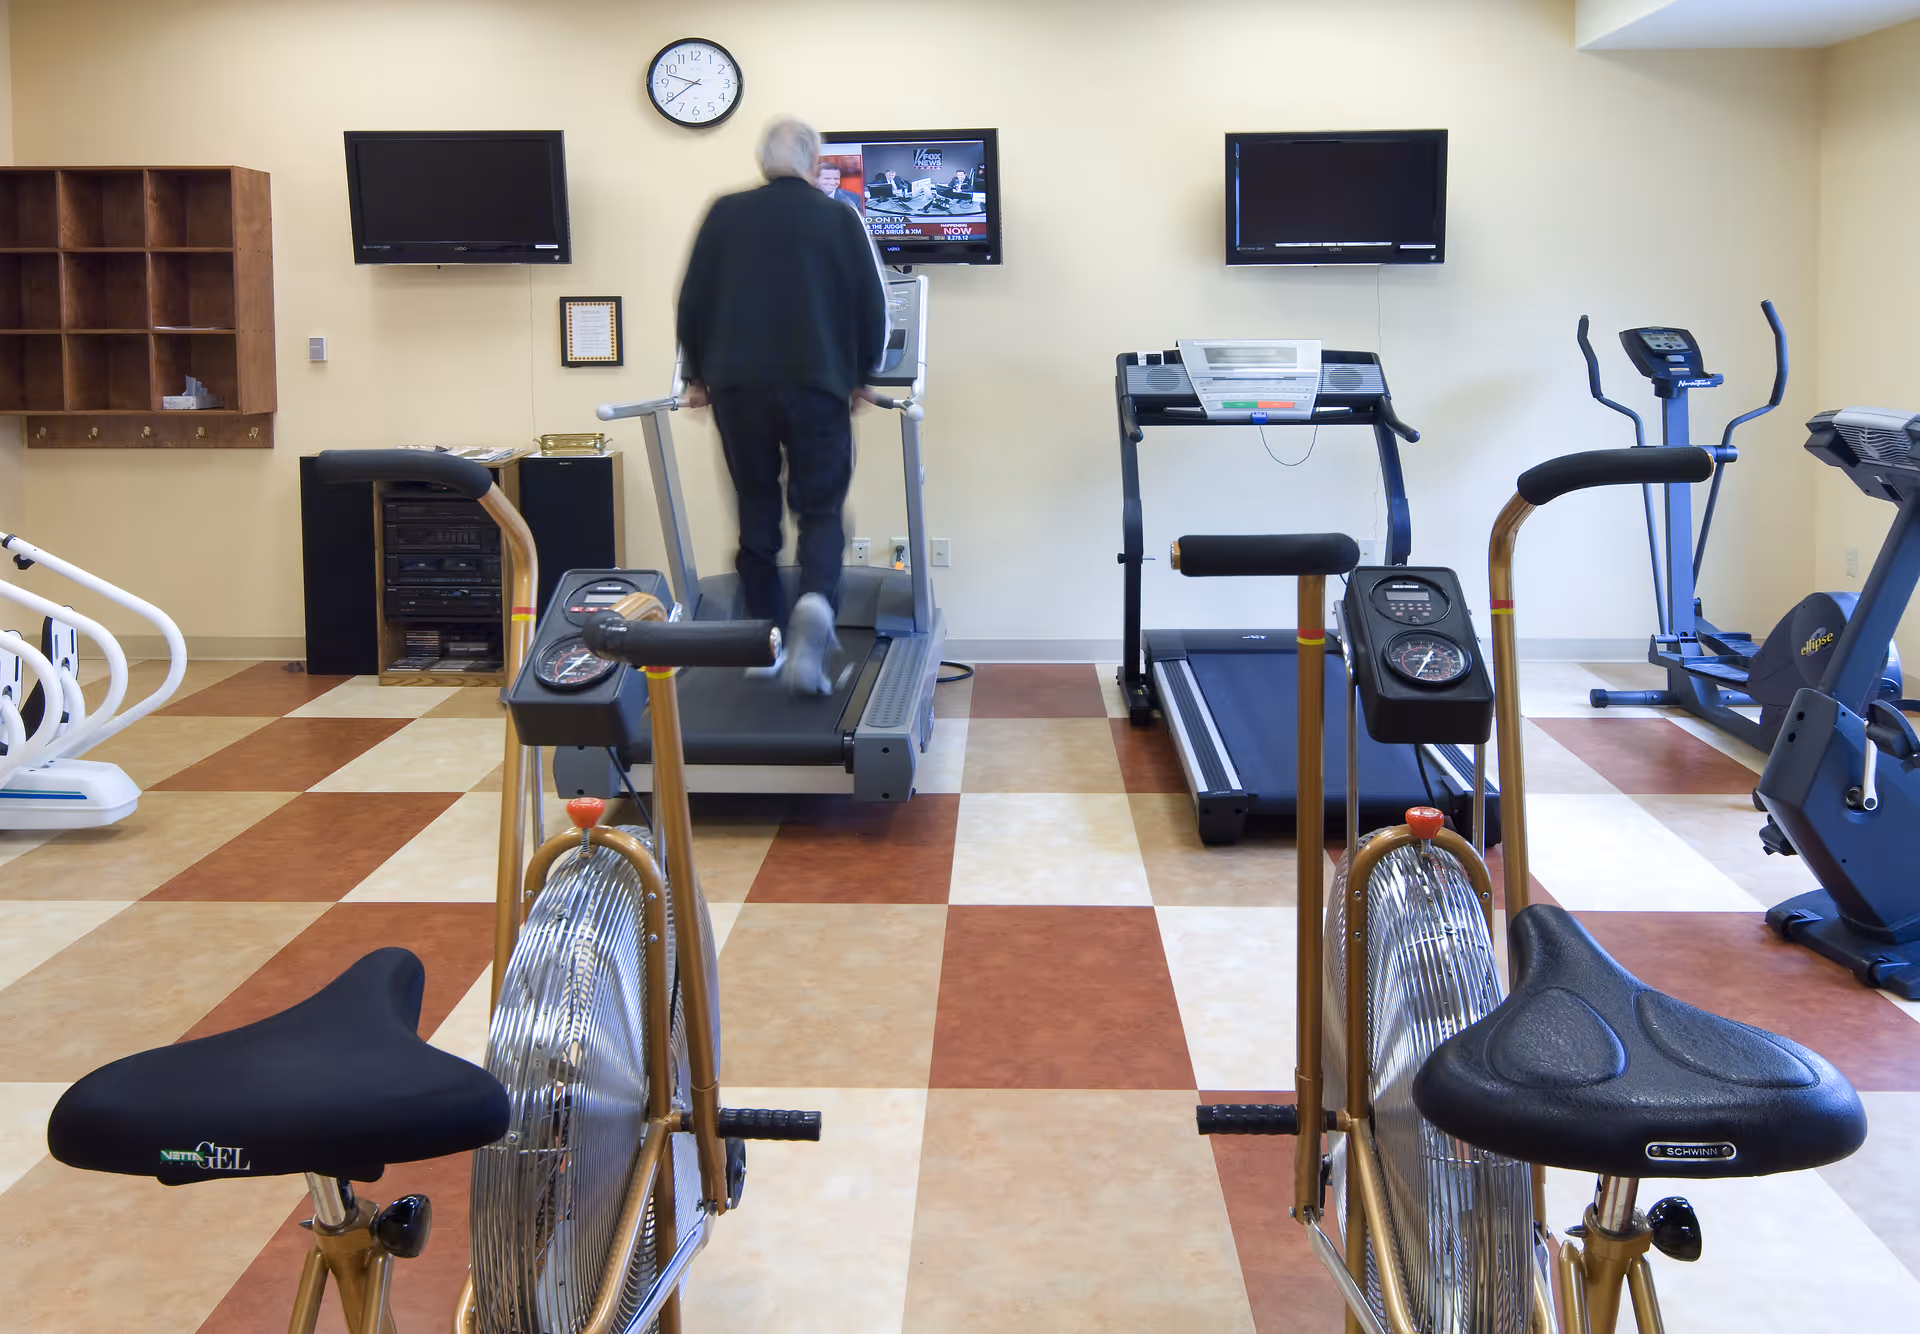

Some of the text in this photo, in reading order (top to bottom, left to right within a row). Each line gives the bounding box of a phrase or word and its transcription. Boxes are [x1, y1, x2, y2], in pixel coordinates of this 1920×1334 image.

[677, 54, 685, 64] 11
[690, 50, 702, 61] 12
[666, 64, 677, 74] 10
[717, 64, 725, 75] 2
[661, 78, 670, 88] 9
[723, 79, 731, 89] 3
[666, 92, 675, 102] 8
[718, 93, 726, 102] 4
[678, 102, 685, 112] 7
[692, 106, 700, 116] 6
[707, 102, 715, 112] 5
[1800, 633, 1833, 656] ellipse
[160, 1141, 250, 1170] VETTA GEL
[1666, 1147, 1718, 1156] SCHWINN
